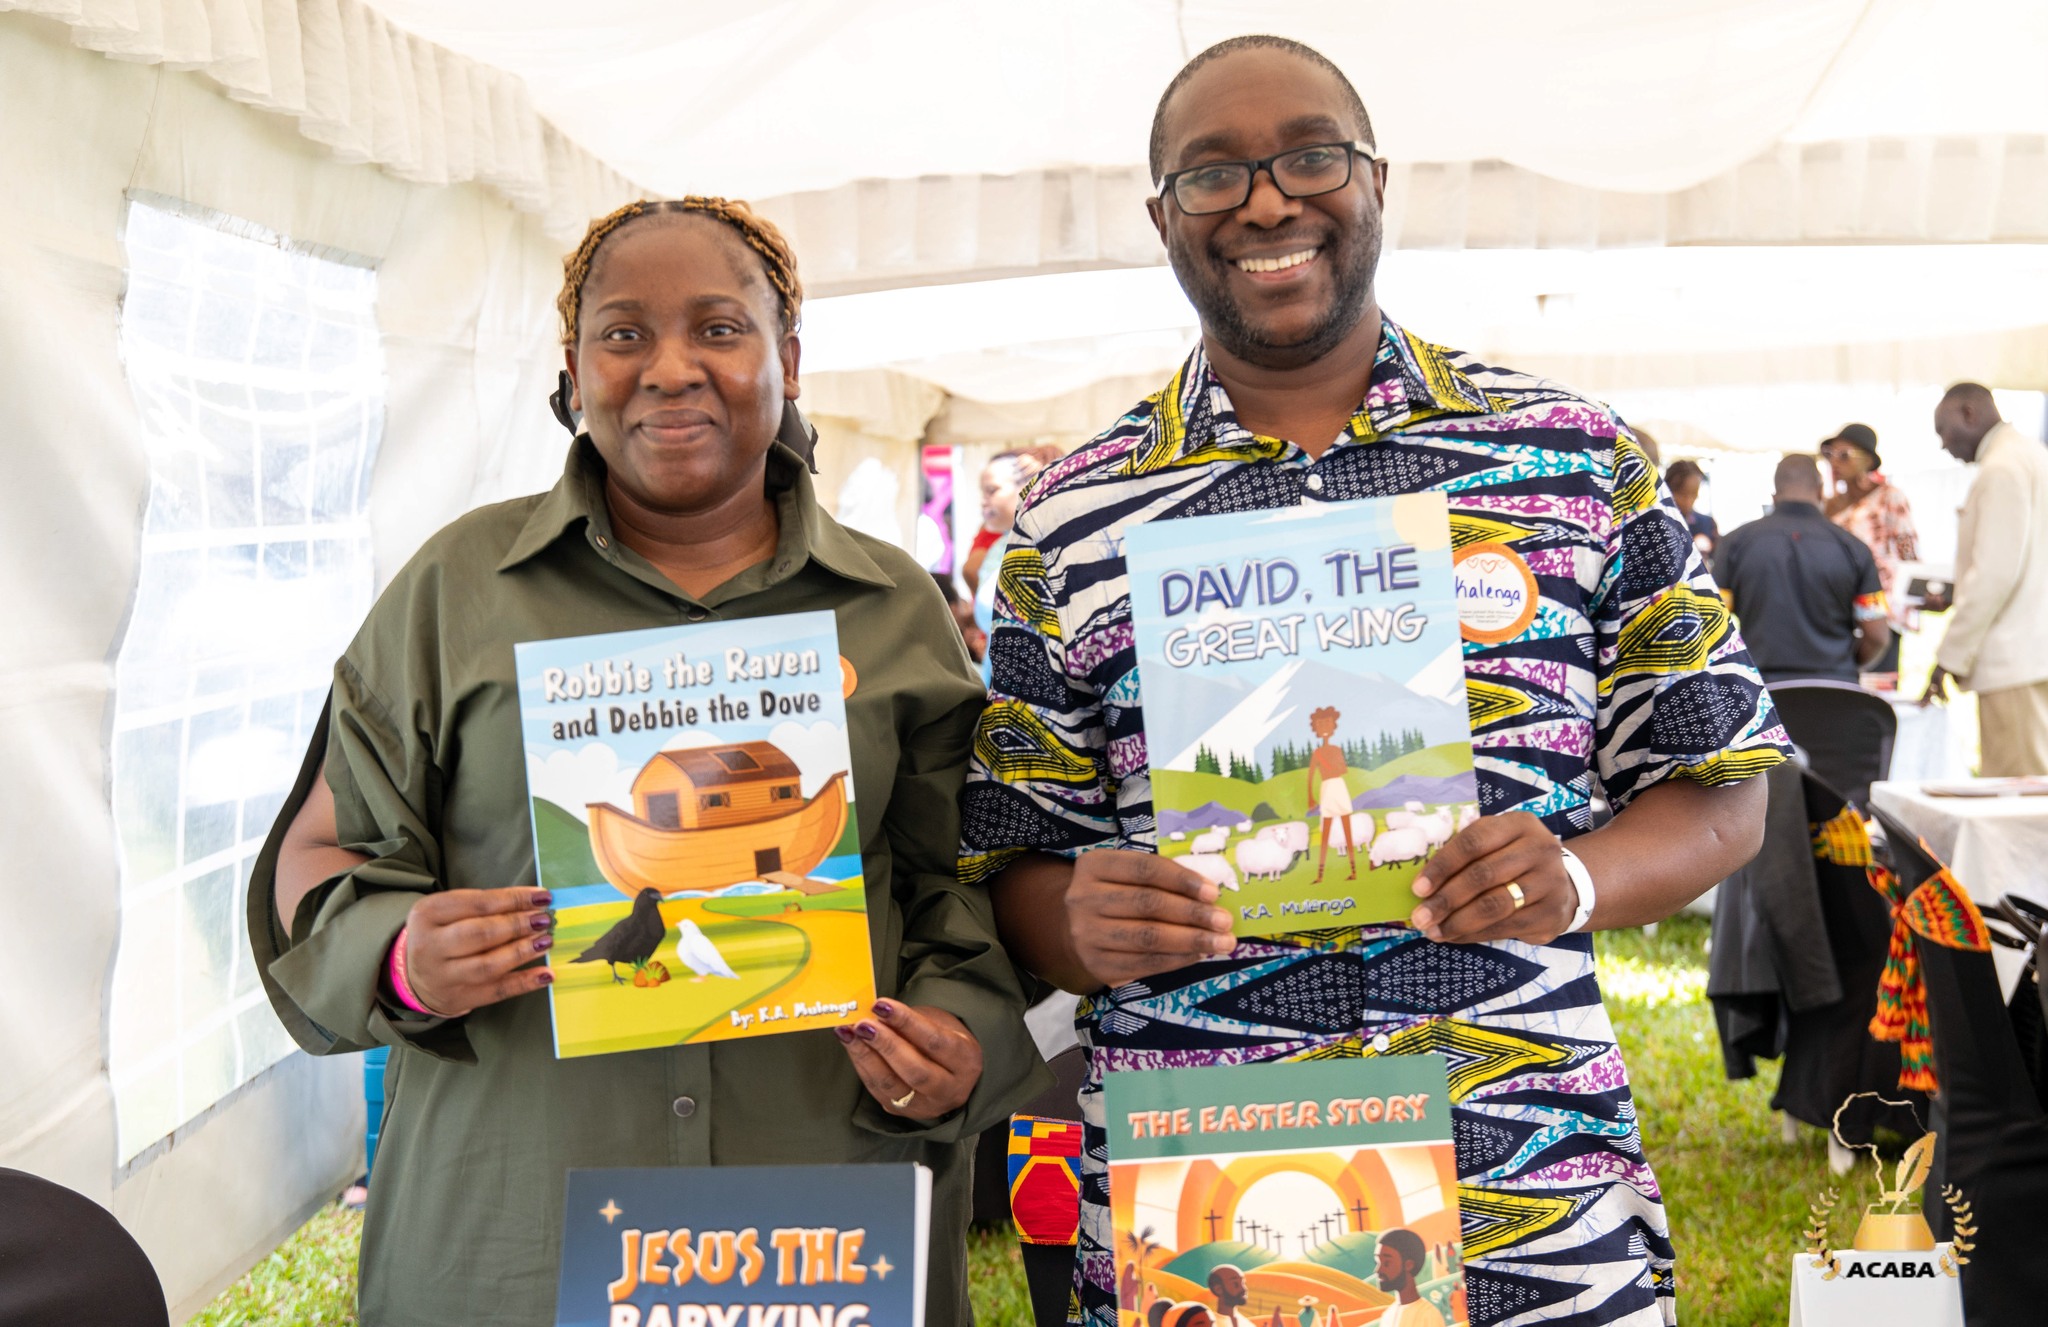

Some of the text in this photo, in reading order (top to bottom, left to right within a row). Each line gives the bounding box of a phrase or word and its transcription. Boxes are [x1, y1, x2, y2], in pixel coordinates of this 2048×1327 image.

[1160, 545, 1420, 618] DAVID, THE
[1164, 604, 1428, 668] GREAT KING
[543, 647, 820, 703] Robbie the Raven
[552, 690, 822, 741] and Debbie the Dove
[1280, 896, 1356, 916] Mulenga
[730, 1000, 858, 1030] By: K.A. Mulenga
[1128, 1093, 1430, 1139] THE EASTER STORY
[607, 1227, 868, 1303] JESUS THE
